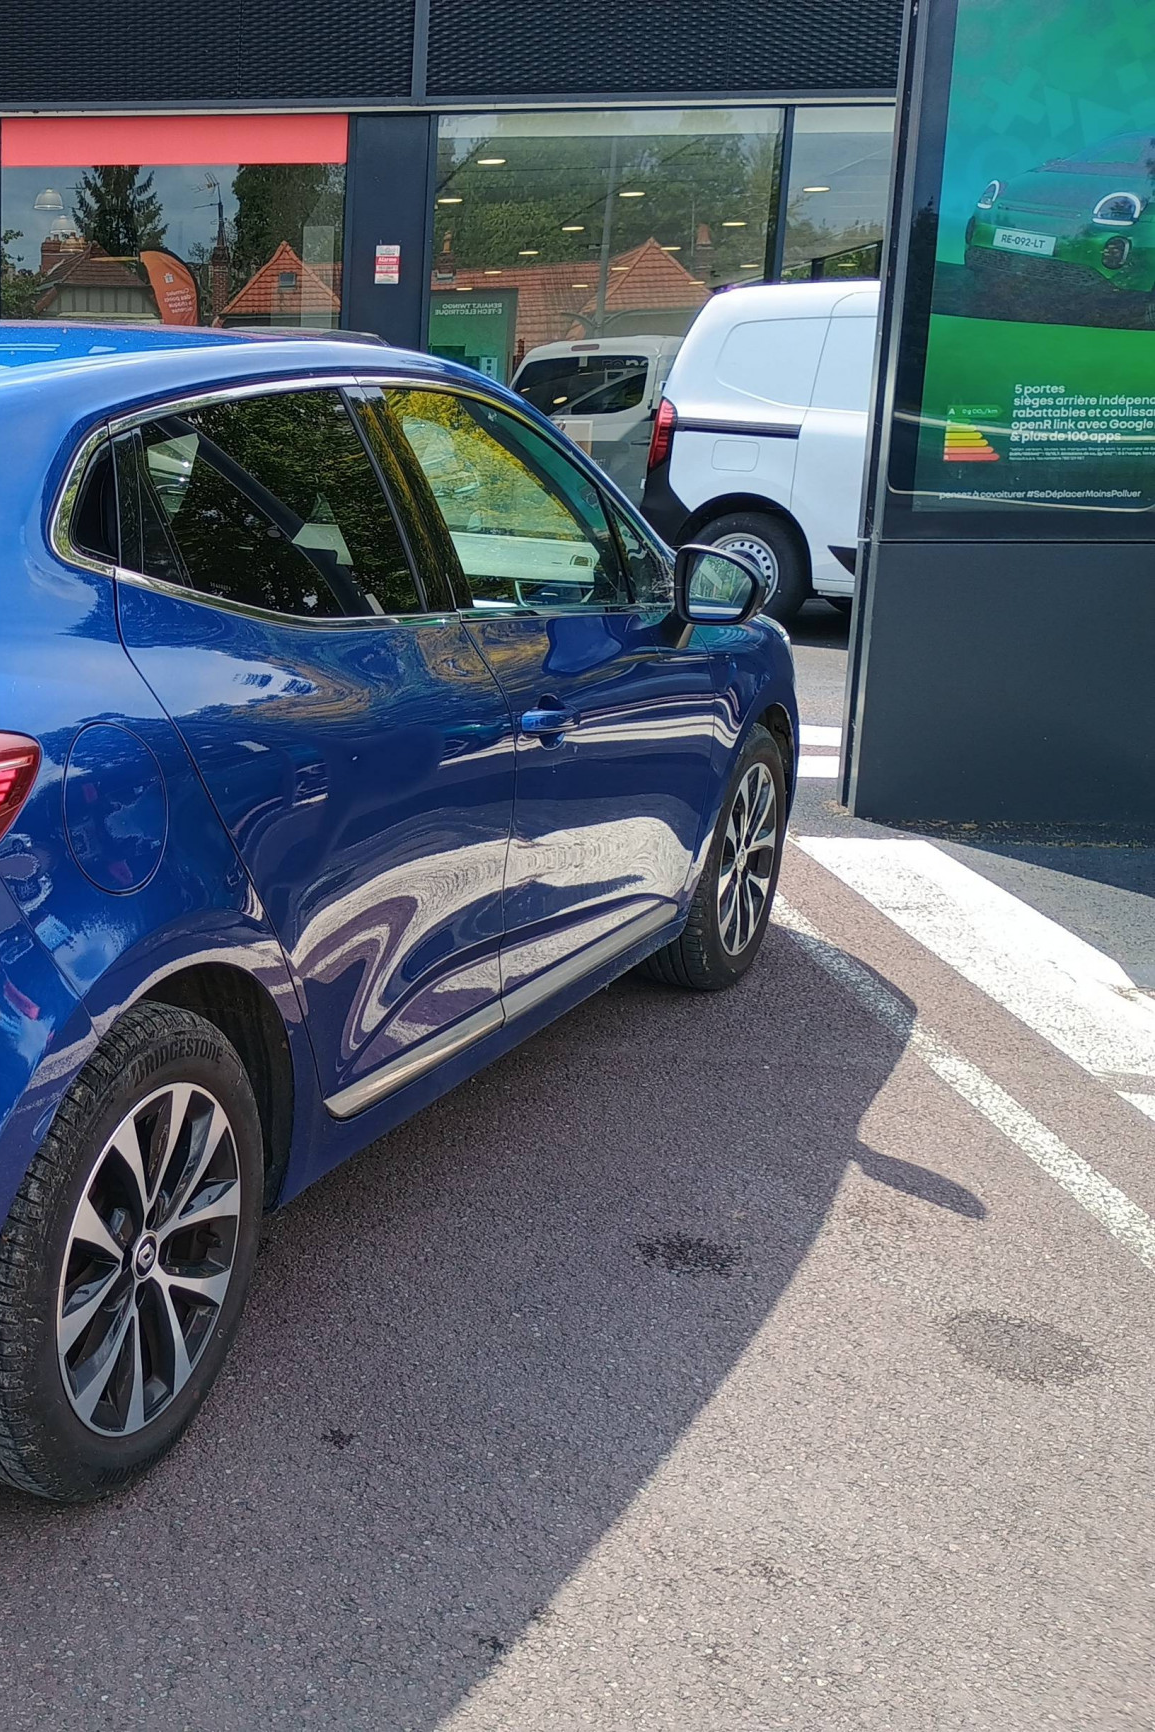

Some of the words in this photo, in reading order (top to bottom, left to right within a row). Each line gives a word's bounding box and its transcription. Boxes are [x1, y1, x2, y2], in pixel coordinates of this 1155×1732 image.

[1001, 233, 1046, 249] RE-092-LT
[1015, 384, 1022, 394] 5
[1024, 384, 1065, 397] portes
[1014, 395, 1054, 408] sièges
[1055, 395, 1097, 406] arrière
[1012, 407, 1086, 418] rabattables
[1088, 408, 1100, 417] et
[1101, 406, 1155, 417] coulissa
[1011, 419, 1052, 431] openR
[1053, 418, 1075, 429] link
[1077, 420, 1107, 430] avec
[1109, 418, 1154, 431] Google
[1010, 431, 1020, 441] &
[1021, 430, 1048, 443] plus
[1049, 430, 1066, 441] de
[1067, 430, 1088, 441] 100
[1089, 432, 1121, 443] apps
[939, 491, 972, 500] pensez
[980, 490, 1026, 498] covoiturer
[1026, 489, 1142, 499] #SeDéplacerMoinsPolluer
[132, 1038, 223, 1088] BRIDGESTONE
